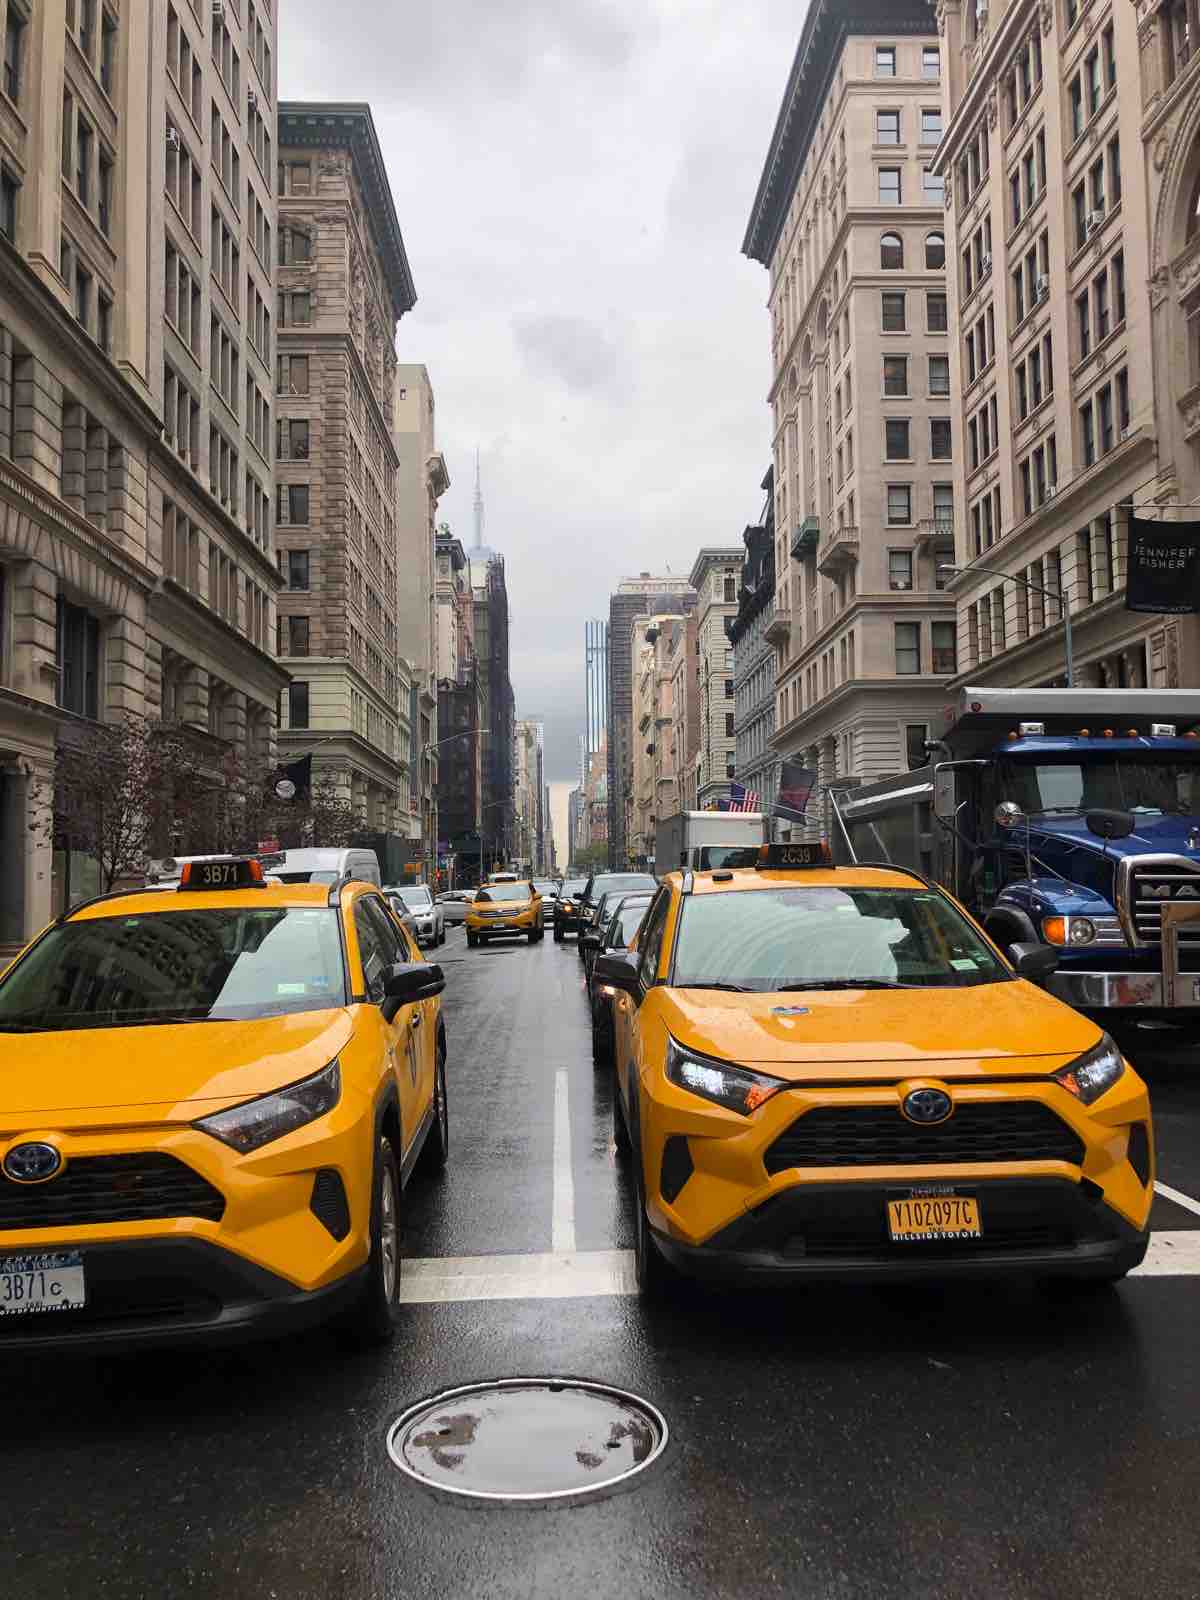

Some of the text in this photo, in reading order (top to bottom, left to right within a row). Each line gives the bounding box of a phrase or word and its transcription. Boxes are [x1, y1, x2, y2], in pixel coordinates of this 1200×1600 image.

[1139, 557, 1185, 569] FISHER
[203, 864, 239, 882] 3B71
[894, 1201, 972, 1227] Y102097C
[942, 1231, 981, 1239] TOYOTA
